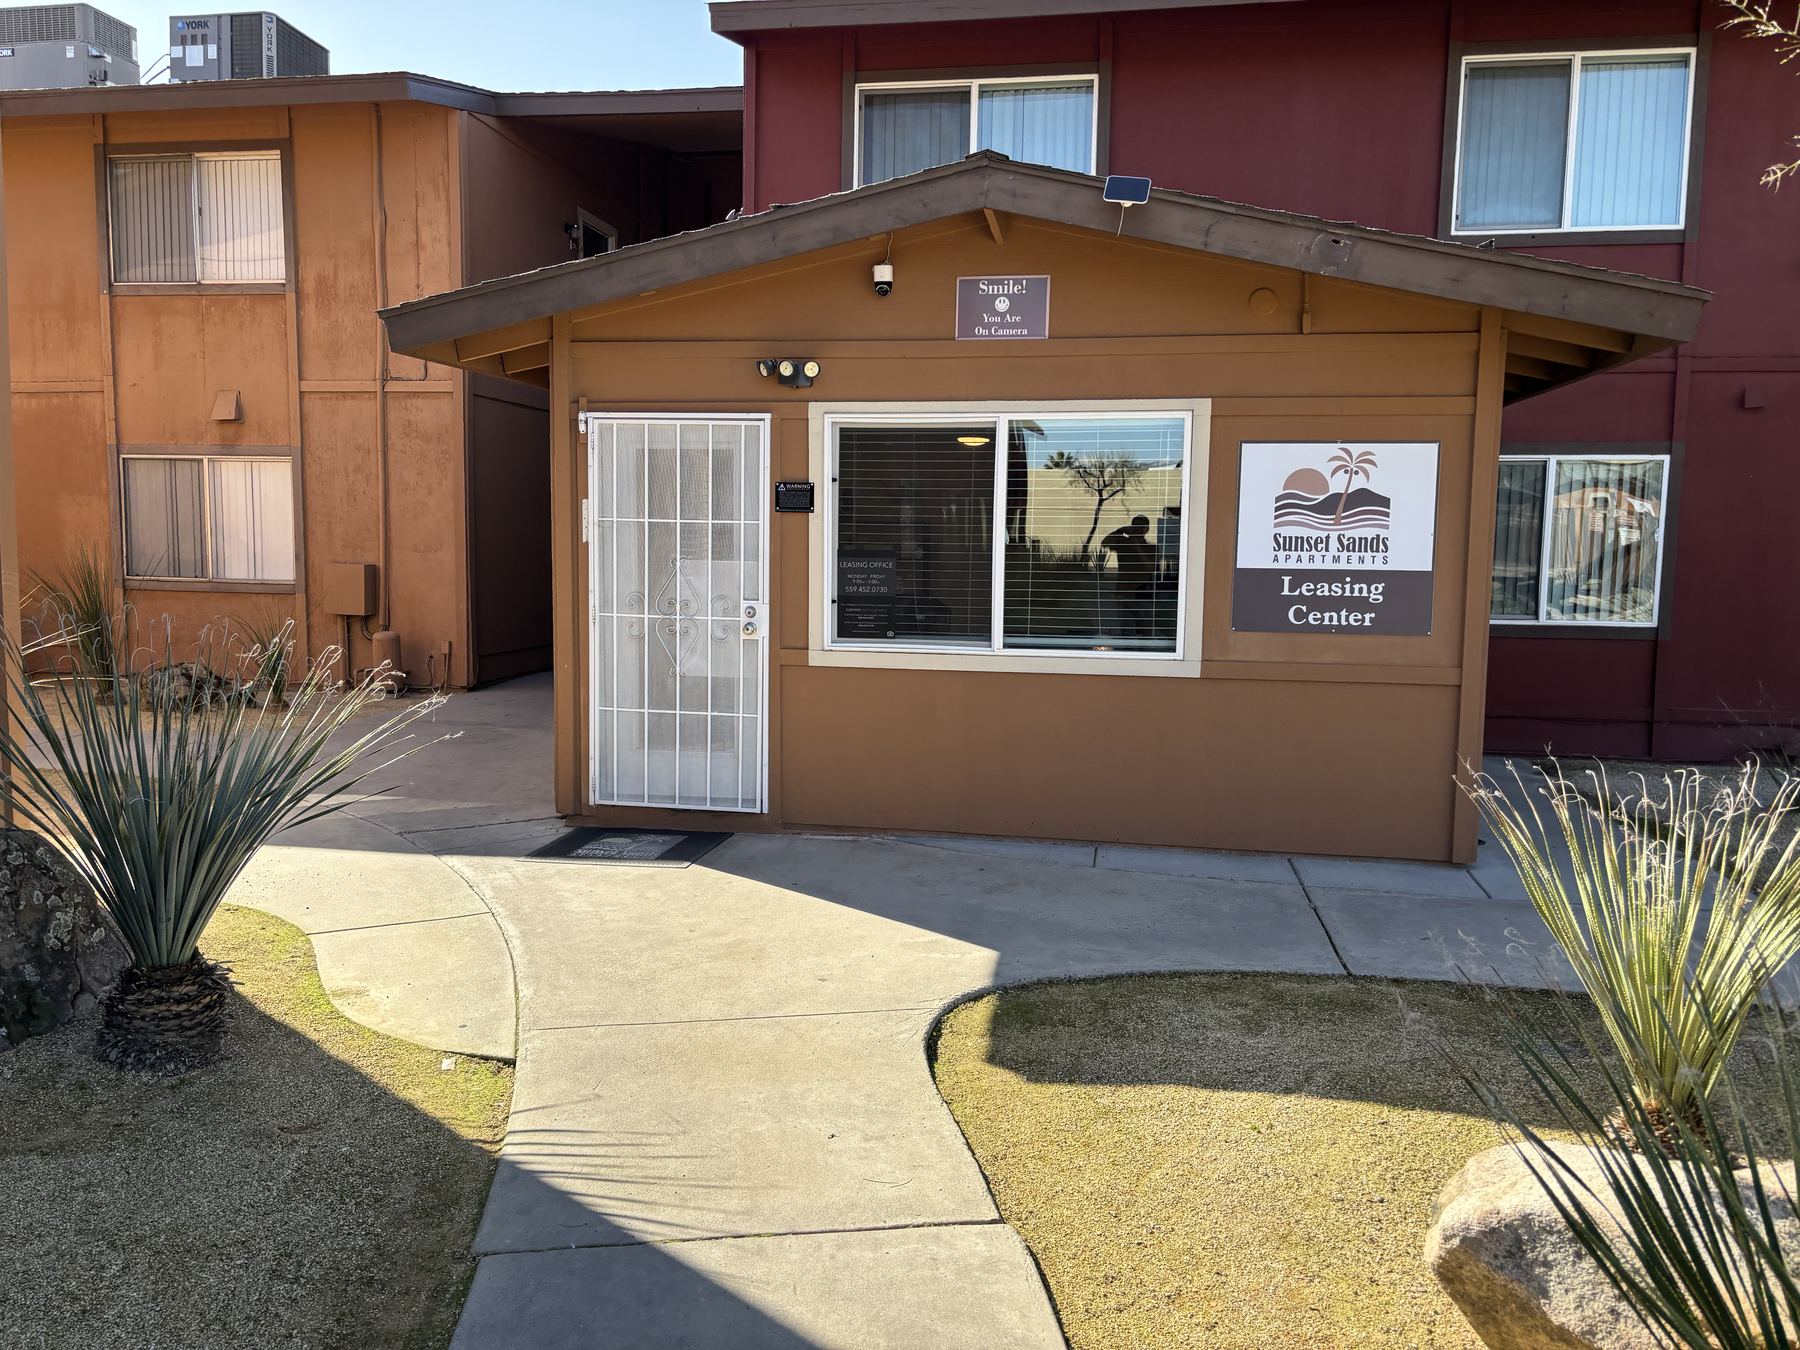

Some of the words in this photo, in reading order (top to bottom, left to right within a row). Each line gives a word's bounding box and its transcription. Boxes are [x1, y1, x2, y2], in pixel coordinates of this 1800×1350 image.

[185, 20, 210, 30] YORK
[979, 279, 1027, 295] Smile!
[983, 313, 1001, 323] You
[1004, 313, 1022, 323] Are
[975, 326, 989, 336] On
[992, 326, 1028, 336] Camera
[1273, 532, 1331, 553] Sunset
[1336, 533, 1389, 554] Sands
[839, 561, 868, 569] LEASING
[869, 561, 894, 569] OFFICE
[1272, 554, 1389, 565] APARTMENTS
[1280, 575, 1385, 604] Leasing
[1288, 604, 1376, 627] Center
